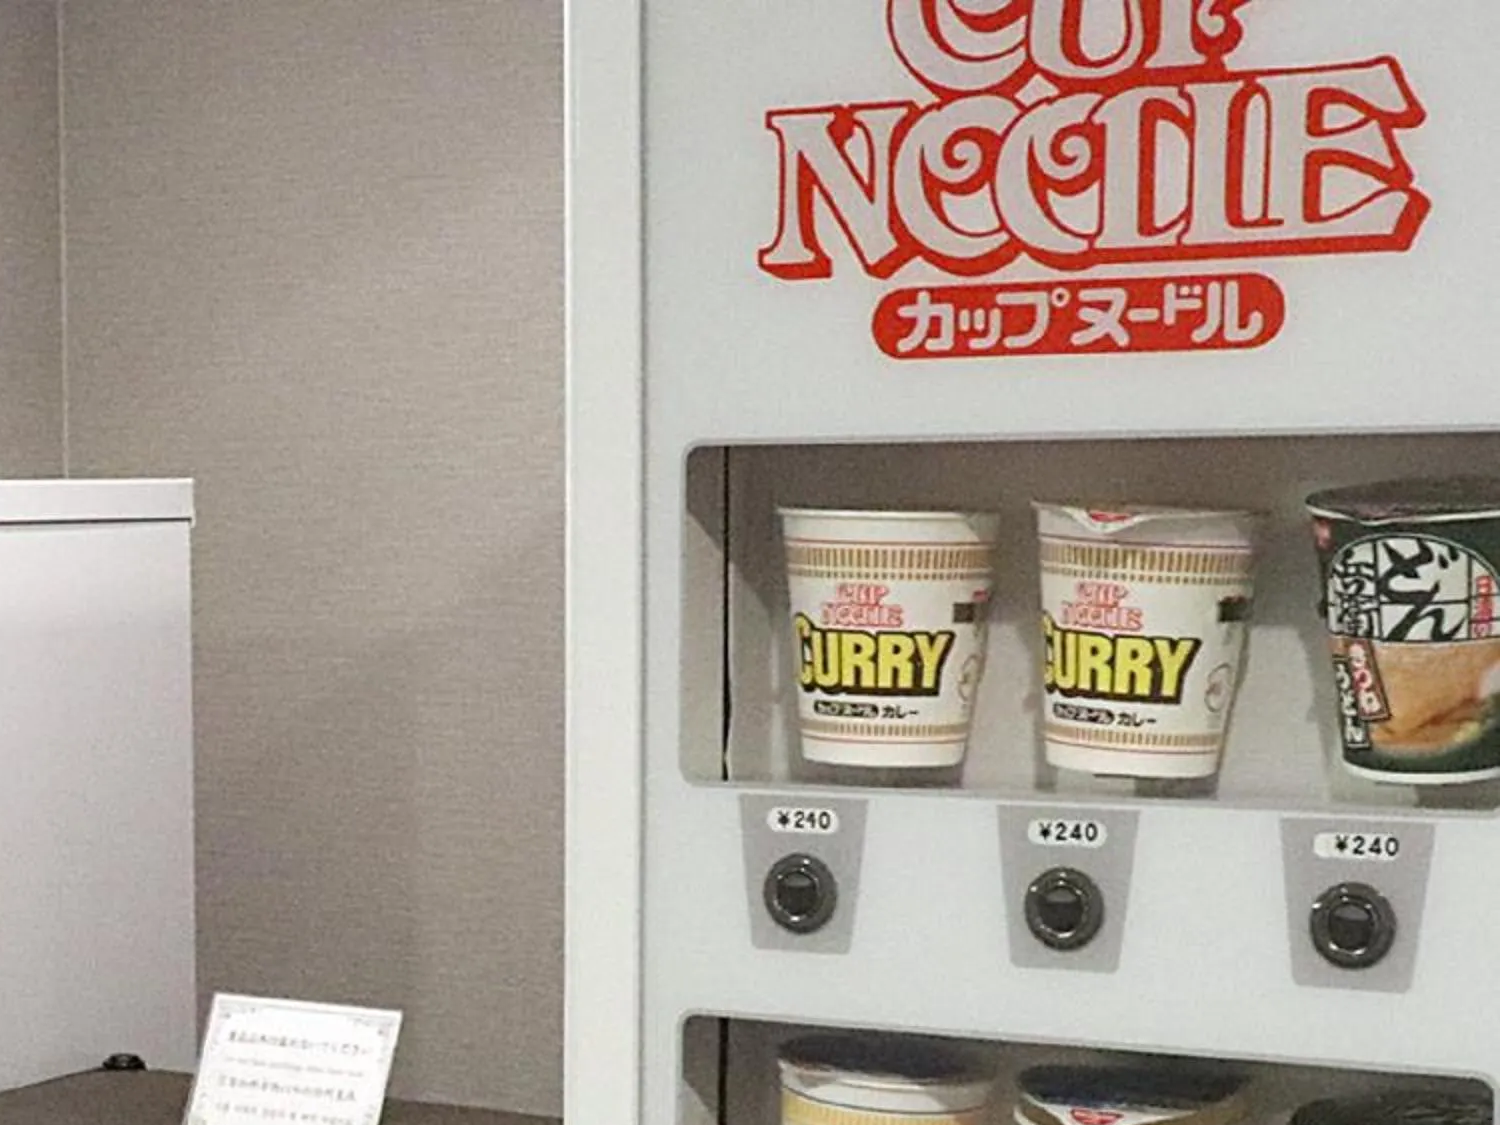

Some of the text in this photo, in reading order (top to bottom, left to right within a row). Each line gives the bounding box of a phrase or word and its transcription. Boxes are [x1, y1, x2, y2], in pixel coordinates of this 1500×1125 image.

[896, 284, 1263, 352] カップヌードル
[777, 809, 831, 831] ¥240
[1039, 821, 1098, 843] ¥240
[1334, 835, 1399, 858] ¥240
